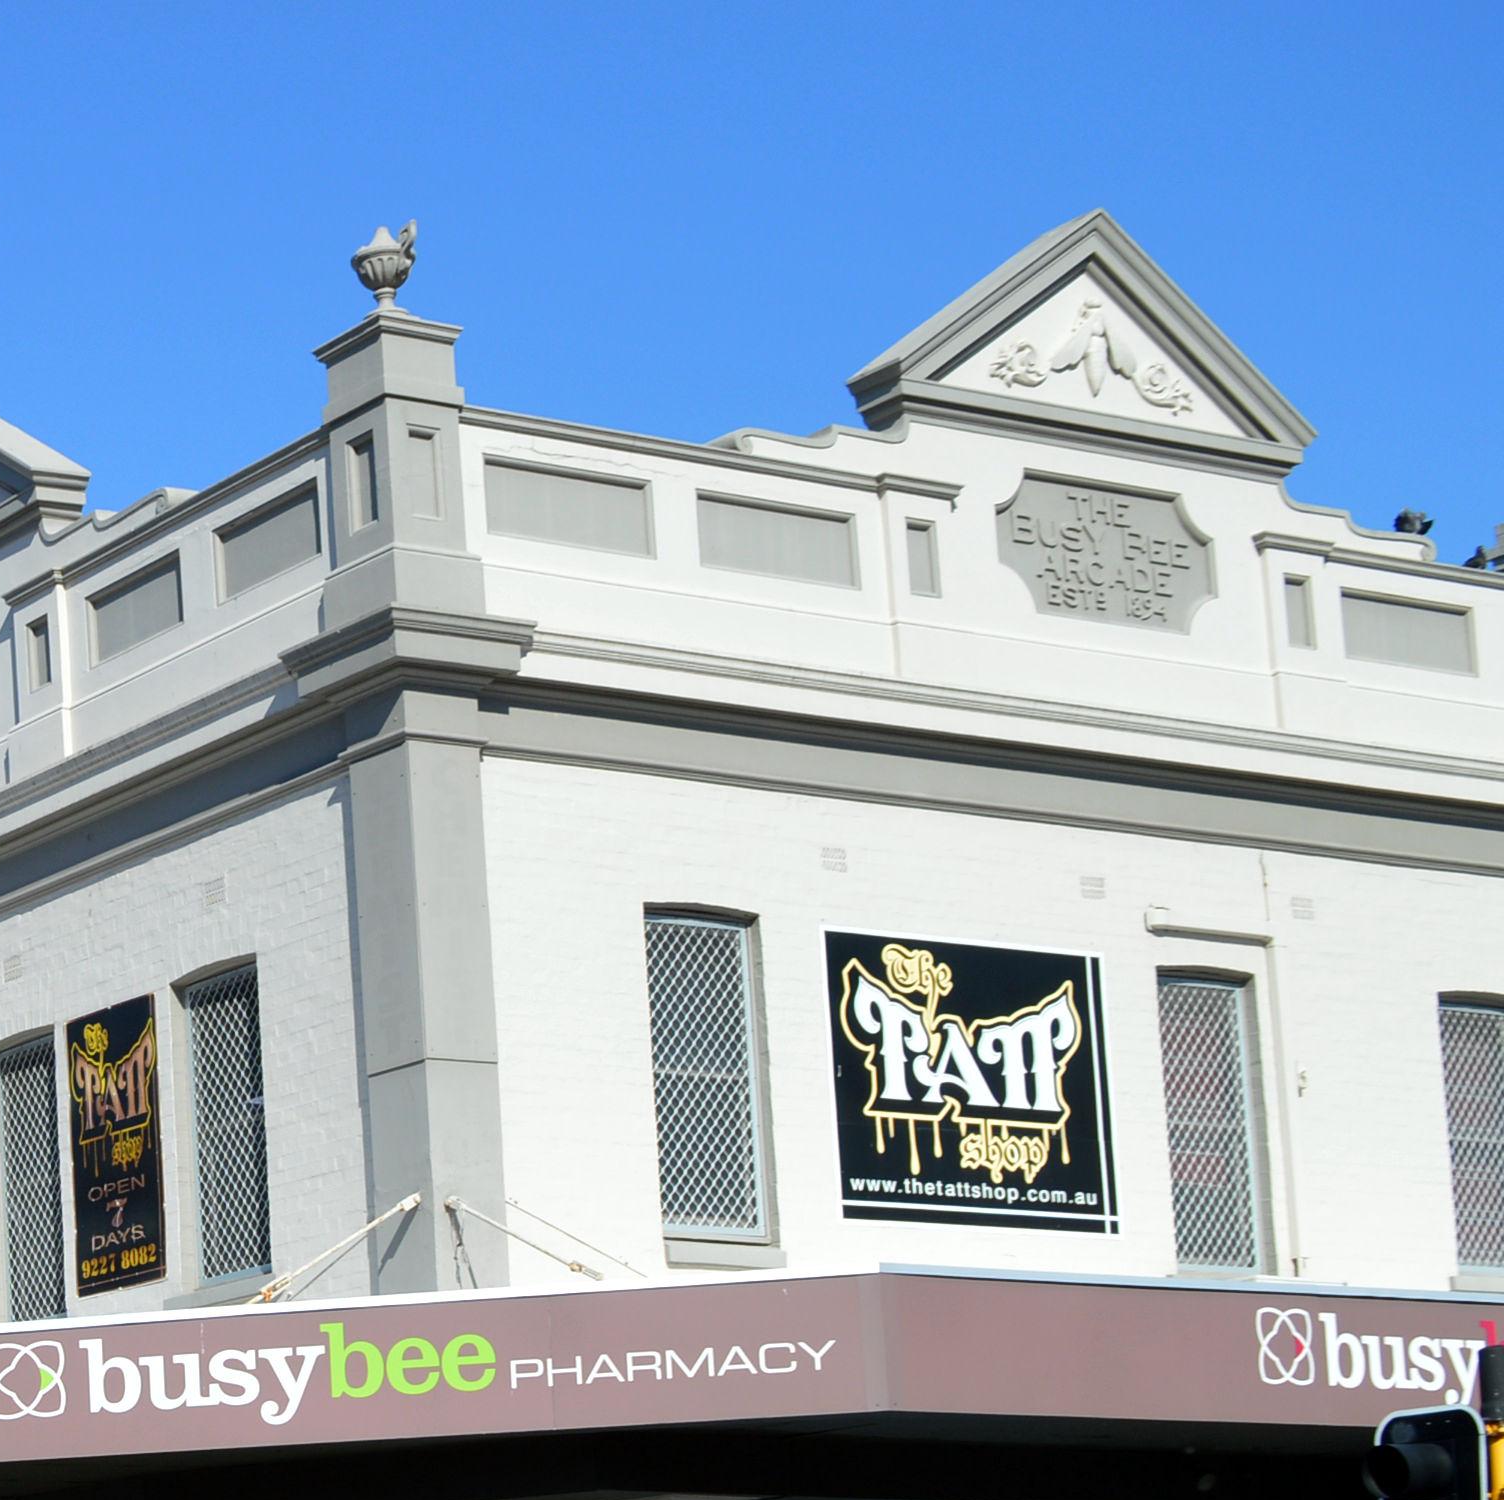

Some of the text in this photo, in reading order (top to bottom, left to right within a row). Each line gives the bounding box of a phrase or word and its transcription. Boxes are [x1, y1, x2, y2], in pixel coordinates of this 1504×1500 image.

[1066, 491, 1132, 529] THE
[1011, 509, 1191, 570] BUSY BEE
[1037, 553, 1174, 599] ARCADE
[1124, 594, 1168, 622] 1894
[881, 943, 953, 996] The
[852, 974, 1077, 1112] TATT
[959, 1132, 1049, 1184] shop
[87, 1173, 146, 1202] OPEN
[849, 1177, 1098, 1205] www.thetattshop.com.au
[105, 1198, 127, 1228] 7
[92, 1224, 146, 1251] DAYS
[81, 1243, 157, 1280] 9227 8082
[79, 1322, 836, 1426] busybee PHARMACY
[1318, 1312, 1504, 1406] busy
